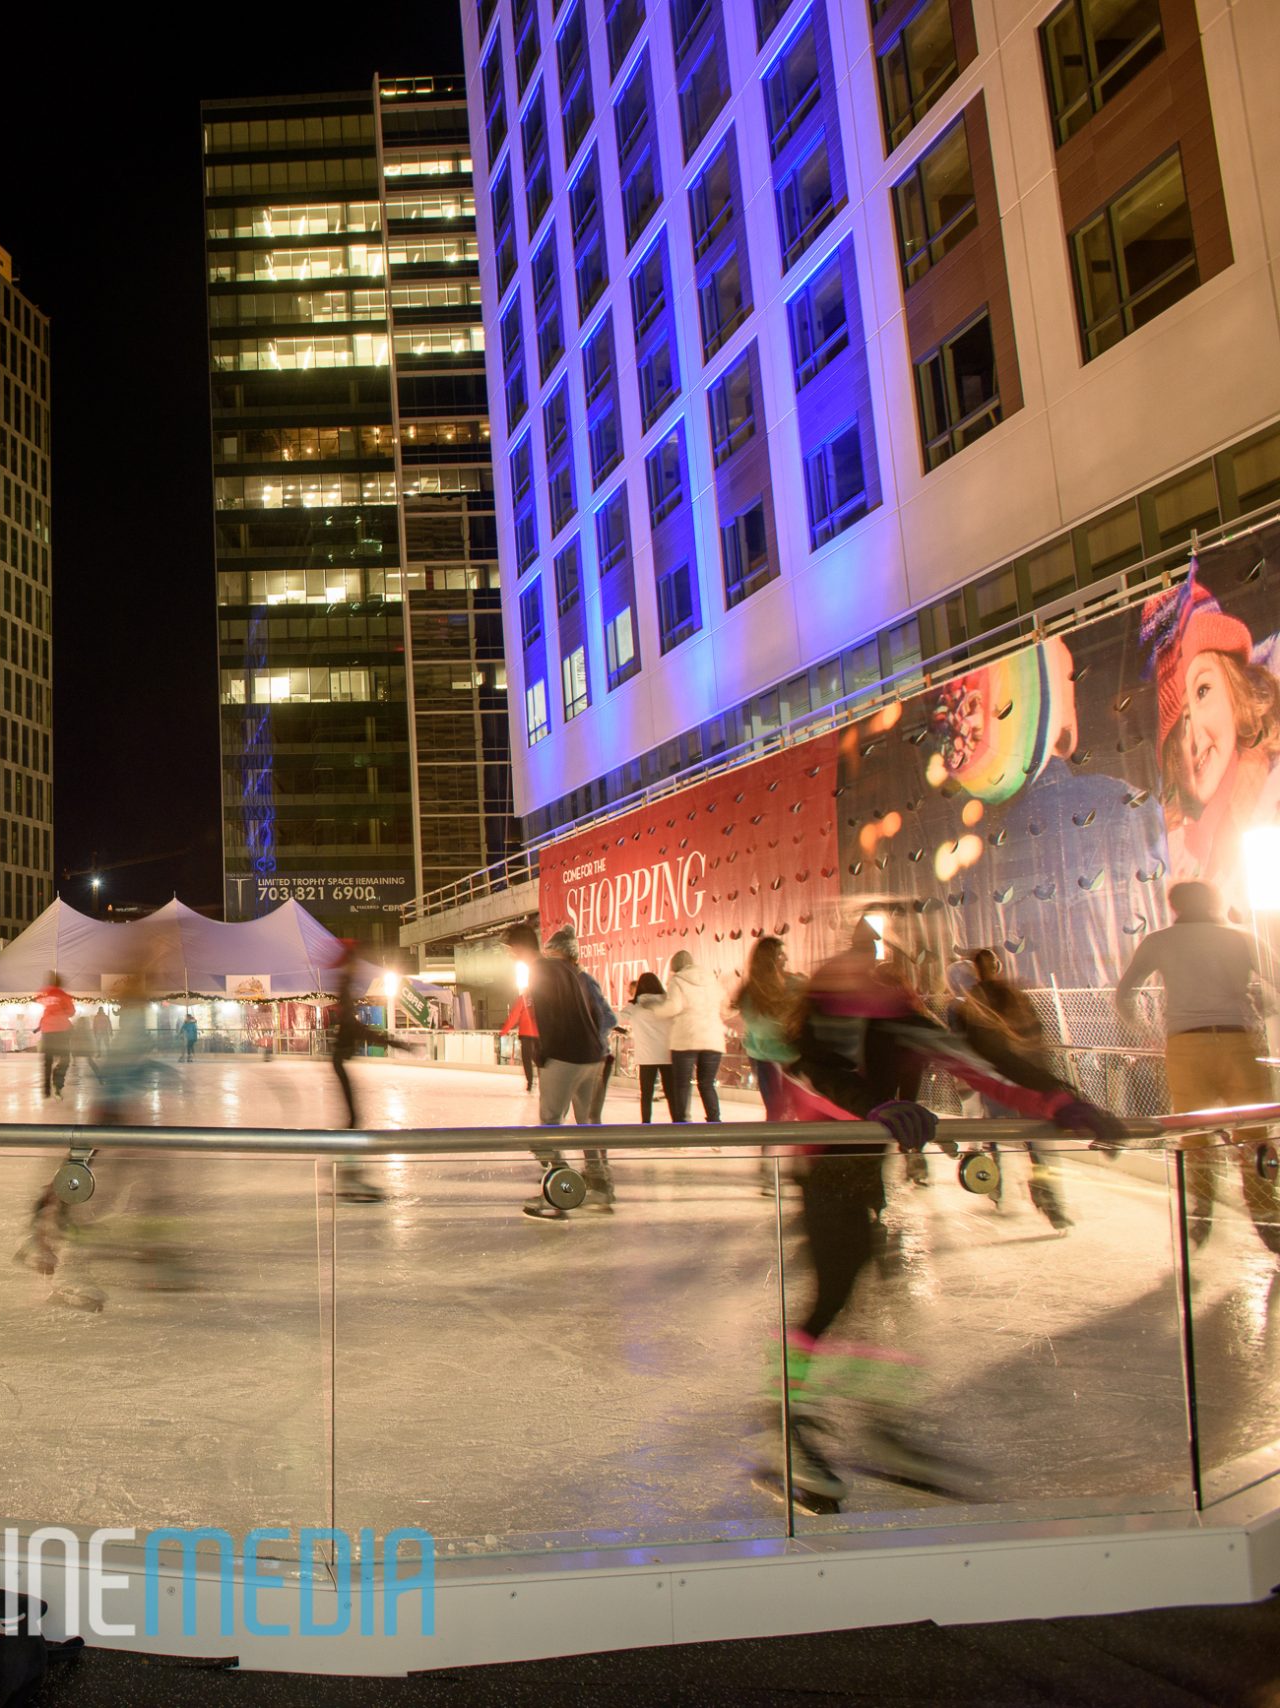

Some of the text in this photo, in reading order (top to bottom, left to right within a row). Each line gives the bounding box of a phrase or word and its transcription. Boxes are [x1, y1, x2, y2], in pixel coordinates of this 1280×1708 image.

[562, 857, 606, 884] COME FOR THE
[257, 877, 406, 886] LIMITED TROPHY SPACE REMAINING
[332, 886, 375, 900] 6900
[566, 850, 706, 939] SHOPPING
[580, 942, 606, 959] FOR THE
[402, 987, 425, 1012] CBRE
